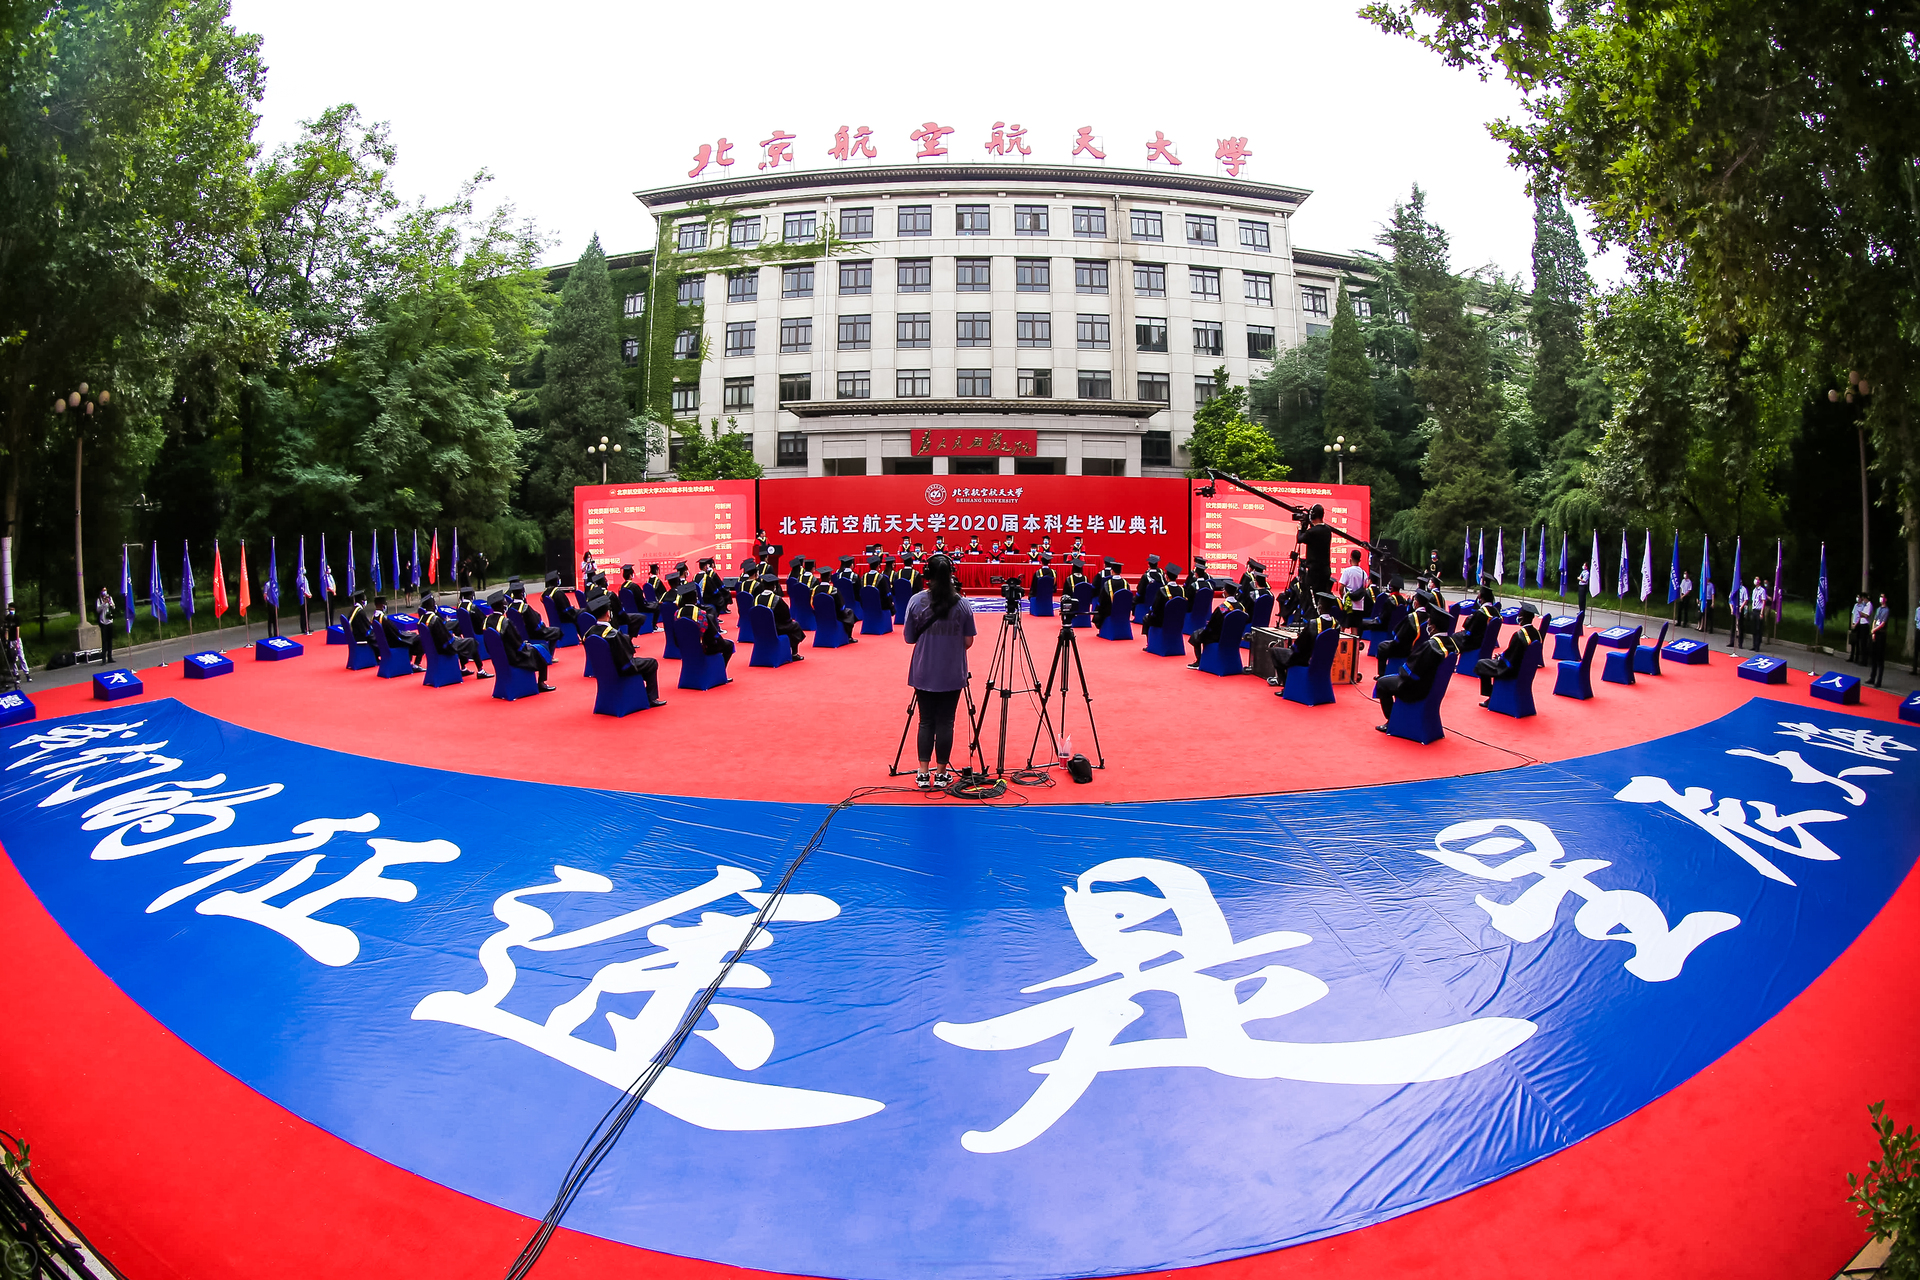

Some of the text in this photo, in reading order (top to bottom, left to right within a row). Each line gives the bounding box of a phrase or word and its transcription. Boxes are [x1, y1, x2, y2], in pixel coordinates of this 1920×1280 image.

[778, 514, 1168, 535] 北京航空航天大学2020届本科生毕业典礼
[393, 614, 415, 623] 行
[1671, 640, 1697, 651] 敢
[1747, 657, 1774, 669] 为
[104, 672, 129, 684] 才
[1820, 676, 1843, 688] 人
